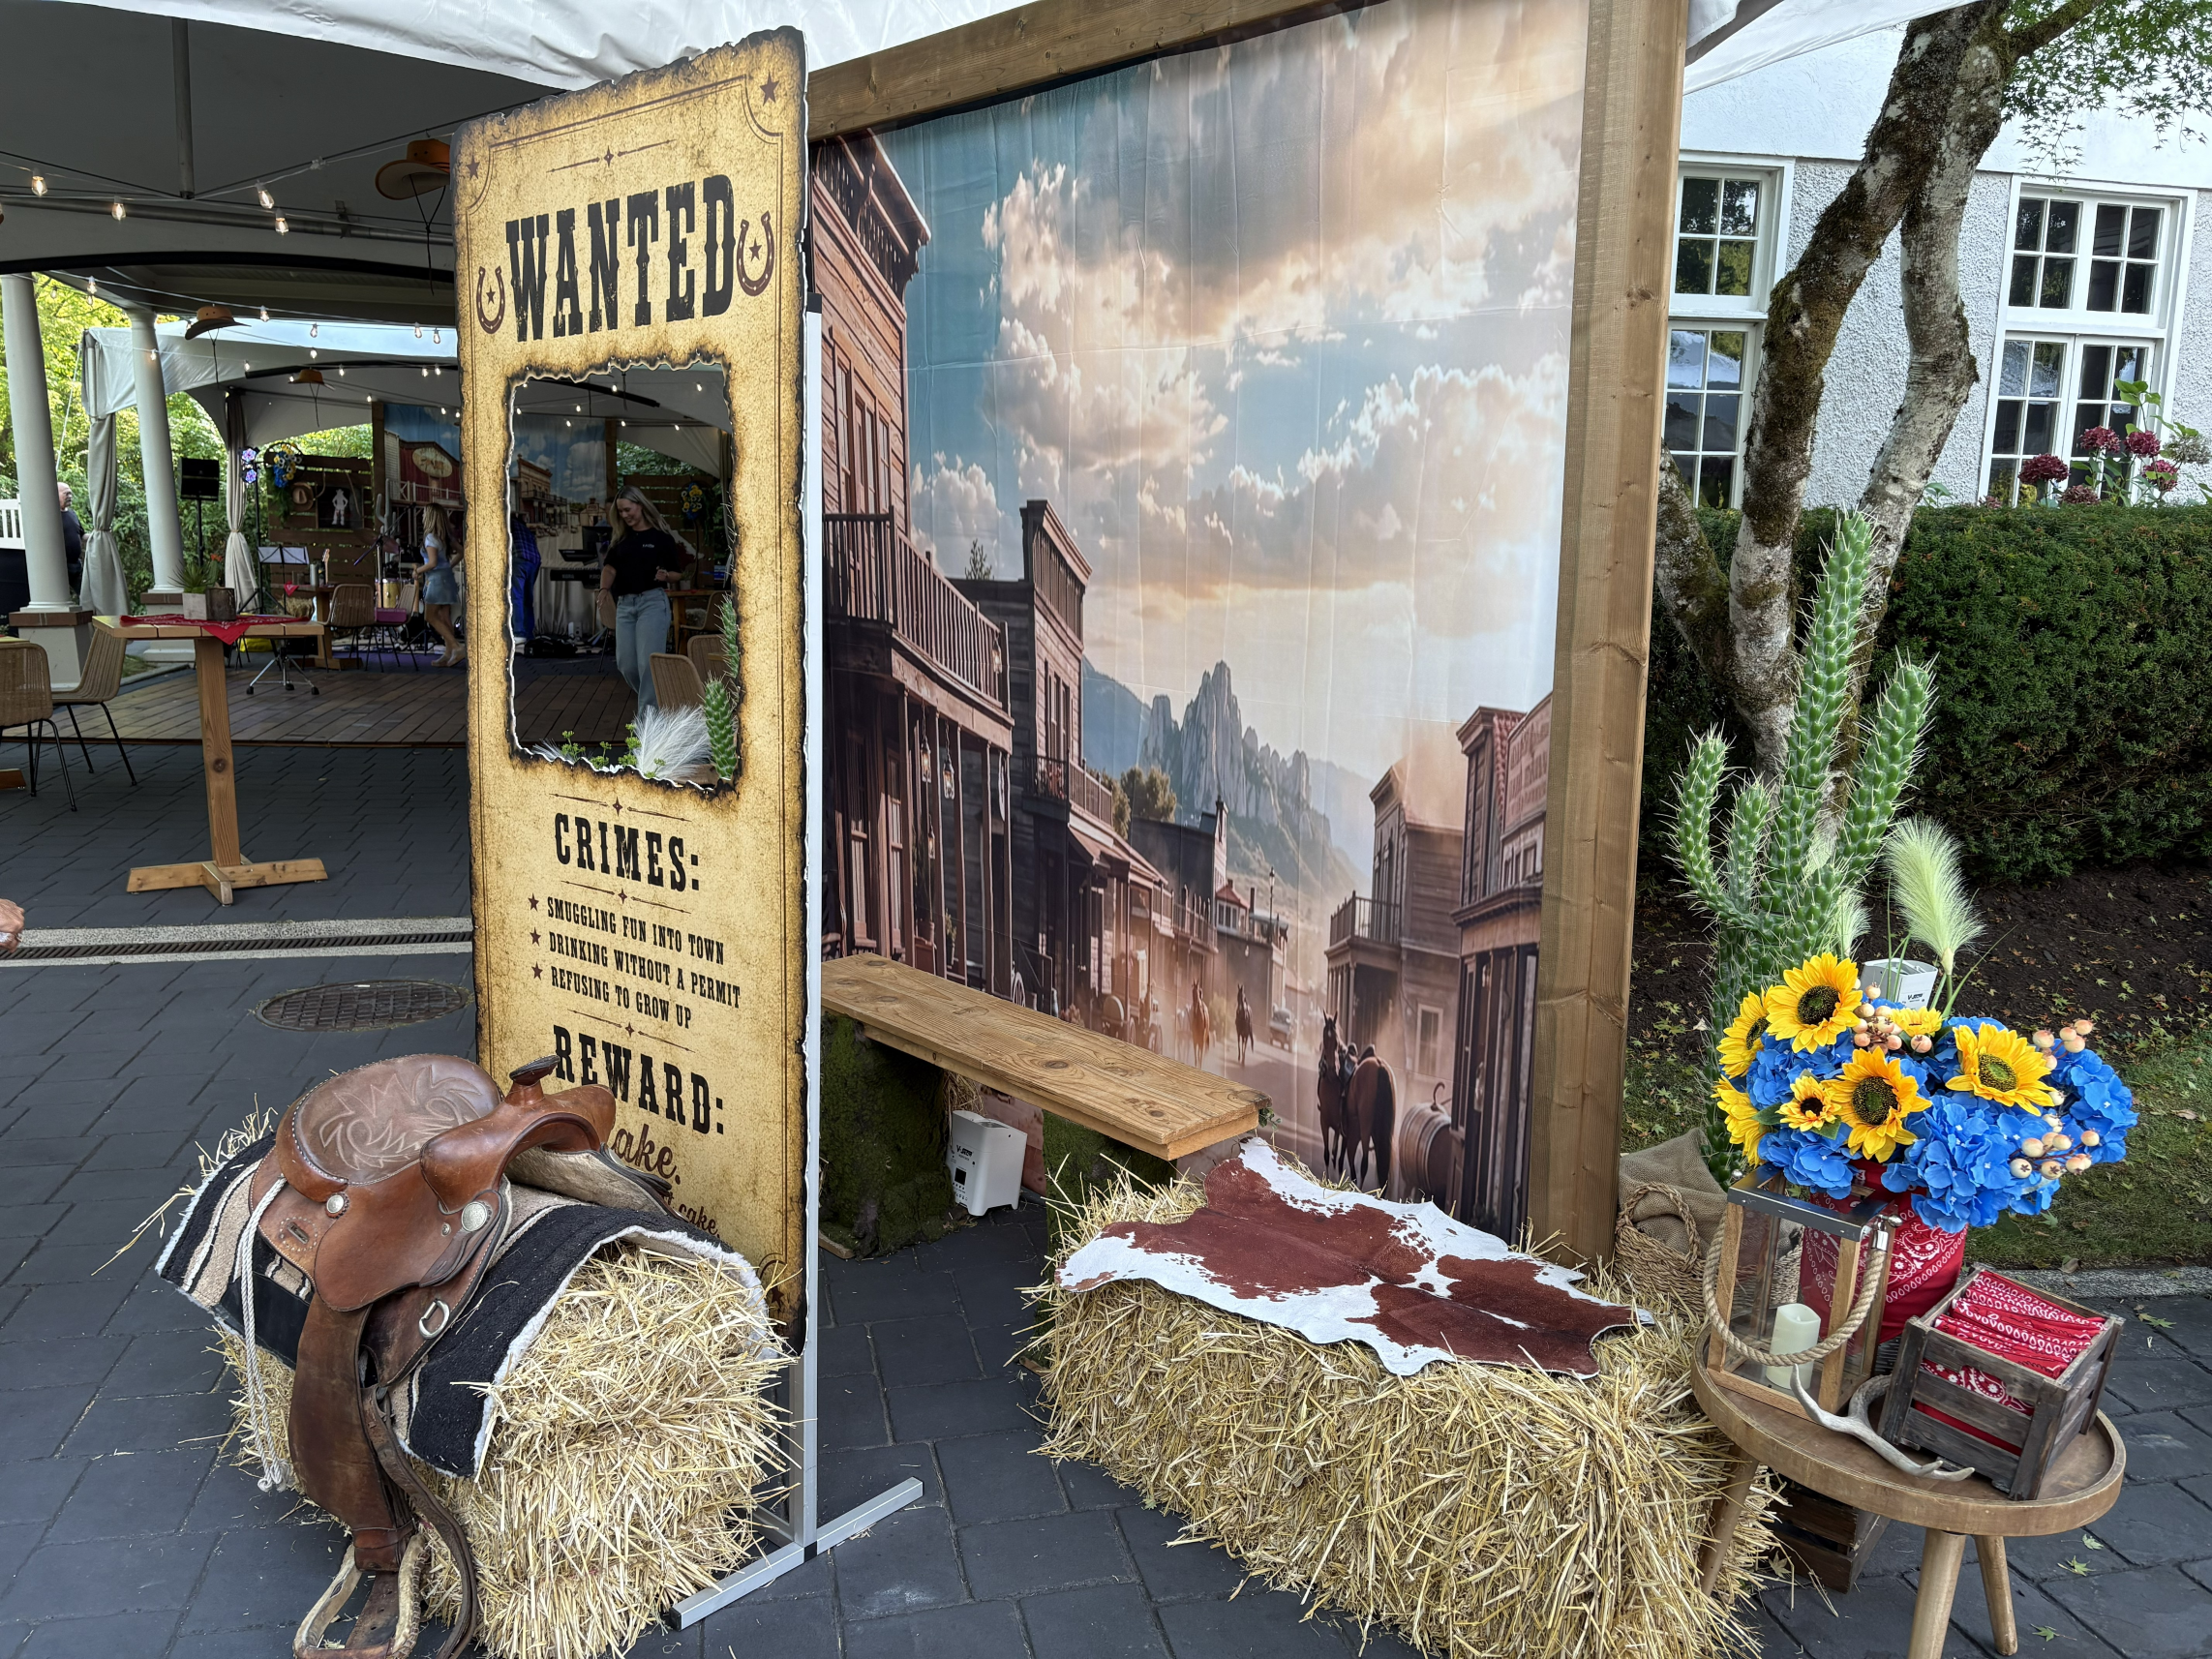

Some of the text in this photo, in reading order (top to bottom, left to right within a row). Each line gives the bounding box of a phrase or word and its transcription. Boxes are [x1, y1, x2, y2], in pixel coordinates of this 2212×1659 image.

[505, 174, 736, 343] WANTED
[555, 812, 700, 892] CRIMES:
[547, 896, 725, 966] SMUGGLING FUN INTO TOWN
[549, 931, 741, 1009] DRINKING WITHOUT A PERMIT
[551, 965, 692, 1030] REFUSING TO GROW UP
[553, 1024, 724, 1135] REWARD:
[611, 1123, 681, 1186] ake.
